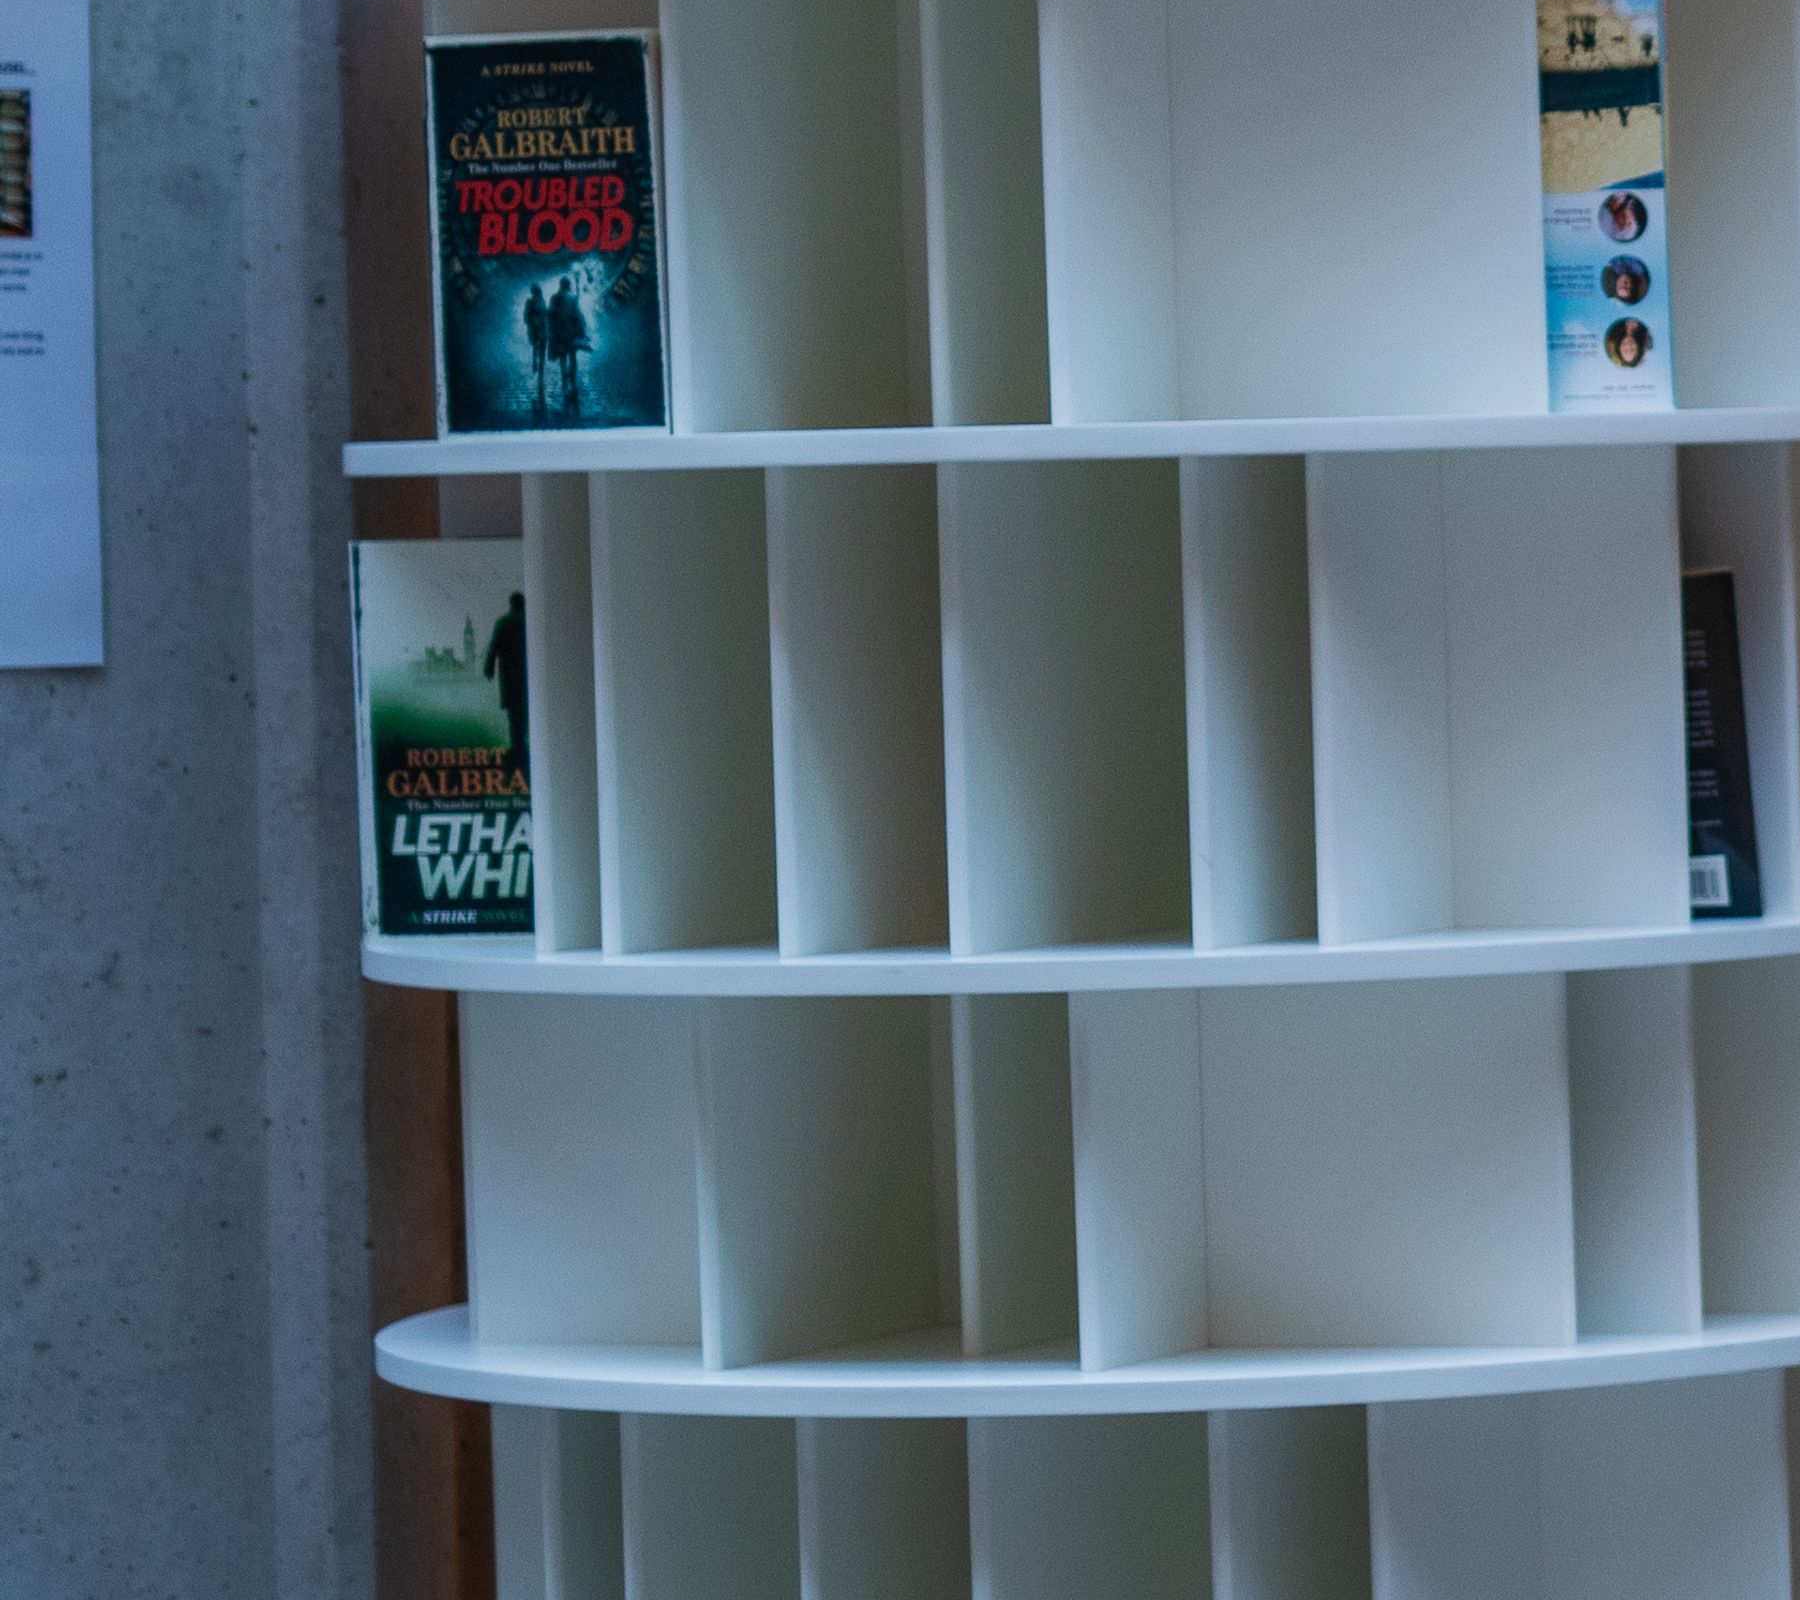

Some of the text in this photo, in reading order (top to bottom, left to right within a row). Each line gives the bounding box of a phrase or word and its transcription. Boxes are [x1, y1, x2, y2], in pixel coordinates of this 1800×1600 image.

[481, 60, 595, 77] A STRIKE NOVEL
[497, 106, 587, 128] ROBERT
[450, 126, 635, 160] GALBRAITH
[468, 163, 489, 175] The
[492, 161, 536, 173] Number
[539, 159, 561, 171] One
[455, 175, 626, 213] TROUBLED
[478, 207, 634, 256] BLOOD
[407, 748, 505, 767] ROBERT
[387, 768, 529, 797] GALBRA
[392, 812, 532, 855] LETHA
[417, 852, 530, 900] WHI
[423, 909, 477, 924] STRIKE
